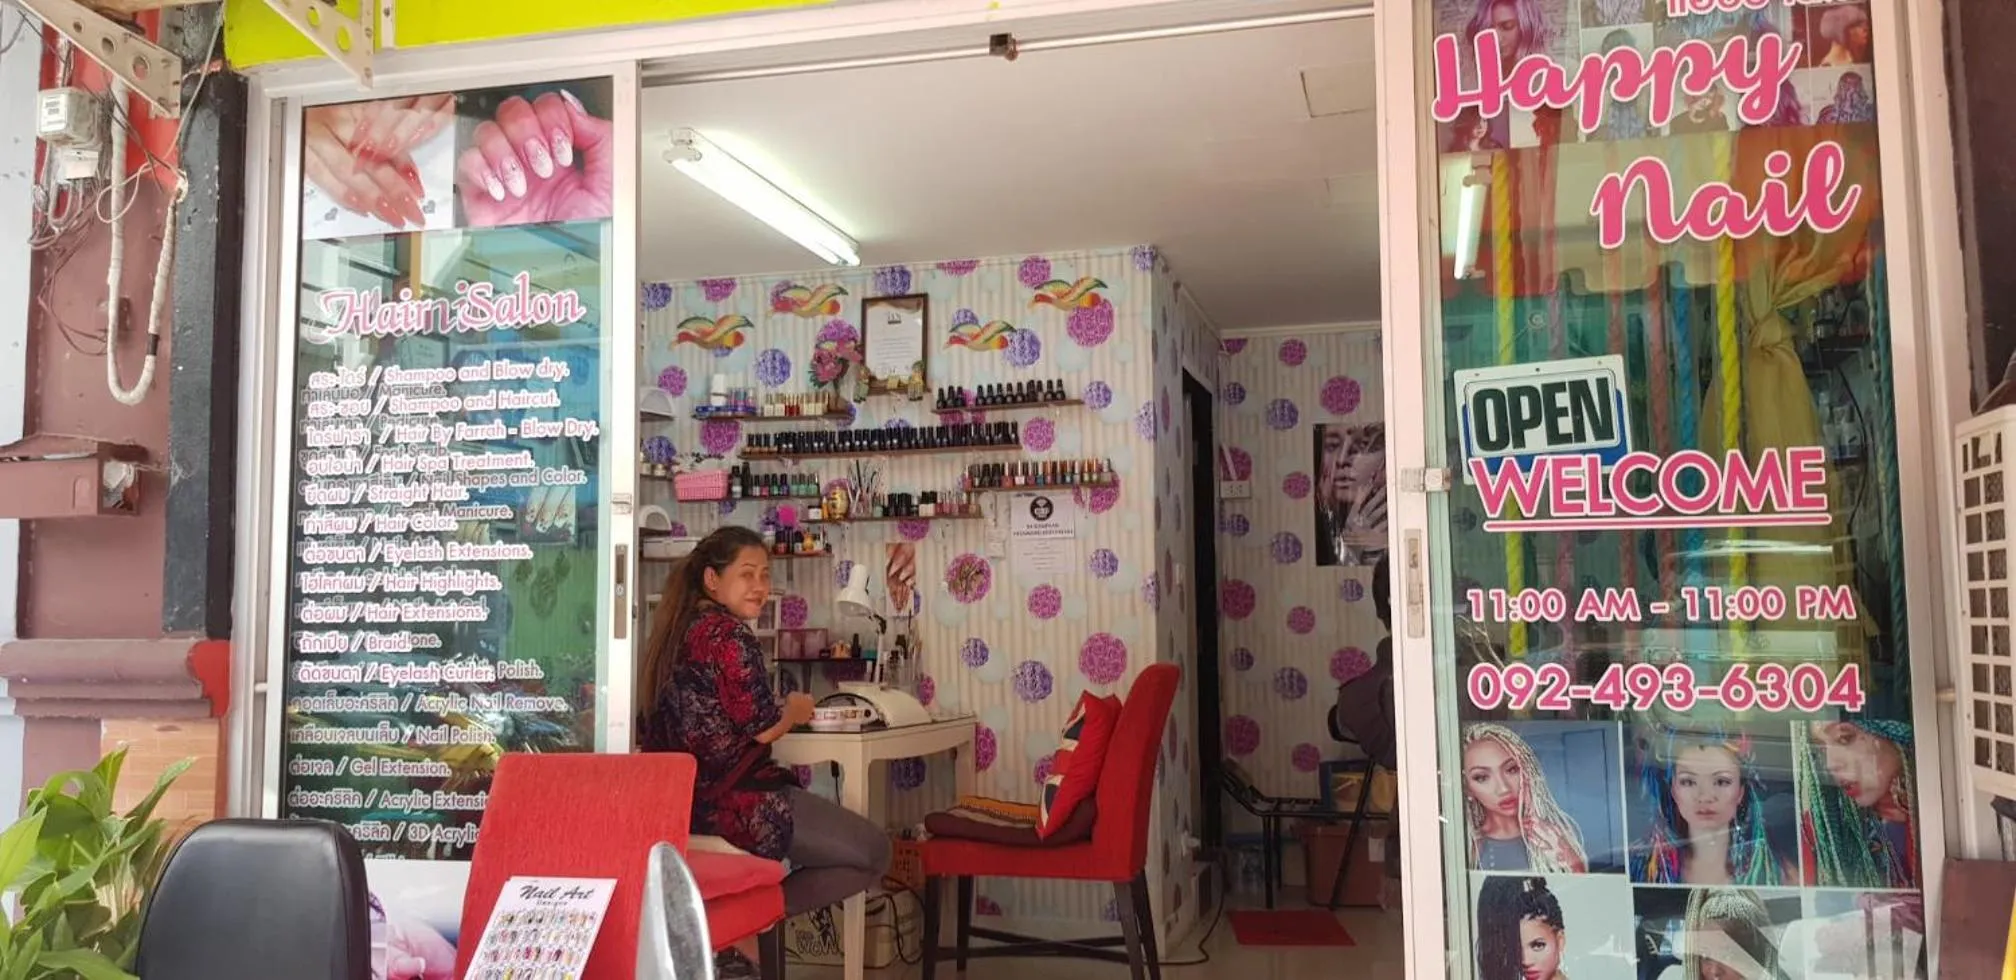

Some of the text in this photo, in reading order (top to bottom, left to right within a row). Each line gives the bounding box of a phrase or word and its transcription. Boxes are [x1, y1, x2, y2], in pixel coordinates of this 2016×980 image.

[1431, 29, 1802, 132] Happy
[1591, 141, 1861, 249] Nail
[320, 287, 432, 336] Hair
[461, 271, 587, 328] Salon
[384, 364, 456, 387] Shampoo
[458, 360, 492, 380] and
[493, 358, 534, 380] Blow
[536, 357, 570, 382] dry.
[389, 394, 462, 417] Shampoo
[464, 389, 496, 411] and
[498, 389, 561, 409] Haircut.
[1472, 377, 1615, 452] OPEN
[395, 422, 429, 443] Hair
[430, 422, 454, 448] By
[456, 418, 506, 441] Farrah
[521, 417, 564, 438] Blow
[565, 417, 599, 441] Dry.
[382, 454, 418, 473] Hair
[418, 454, 448, 475] Spa
[450, 450, 535, 472] Treatment.
[455, 470, 507, 493] Shapes
[509, 467, 540, 486] and
[542, 465, 588, 485] Color.
[1469, 447, 1827, 517] WELCOME
[367, 481, 431, 507] Straight
[431, 481, 470, 501] Hair.
[374, 511, 409, 533] Hair
[410, 511, 459, 531] Color.
[442, 501, 513, 519] Manicure.
[383, 540, 445, 567] Eyelash
[446, 540, 534, 561] Extensions.
[382, 572, 420, 592] Hair
[420, 570, 502, 596] Highlights.
[364, 602, 401, 623] Hair
[401, 600, 487, 621] Extensions.
[1467, 585, 1857, 623] 11:00 AM - 11:00 PM
[379, 661, 441, 688] Eyelash
[497, 658, 544, 679] Polish.
[1467, 662, 1865, 712] 092-493-6304
[400, 692, 414, 712] /
[414, 691, 467, 717] Acrylic
[469, 690, 503, 712] Nail
[504, 692, 569, 712] Remove.
[415, 724, 449, 744] Nail
[450, 723, 497, 744] Polish.
[335, 756, 349, 776] /
[350, 756, 378, 776] Gel
[379, 758, 452, 777] Extension.
[364, 788, 378, 809] /
[379, 788, 431, 814] Acrylic
[393, 821, 406, 841] /
[408, 822, 430, 842] 3D
[520, 885, 595, 899] Nail Art
